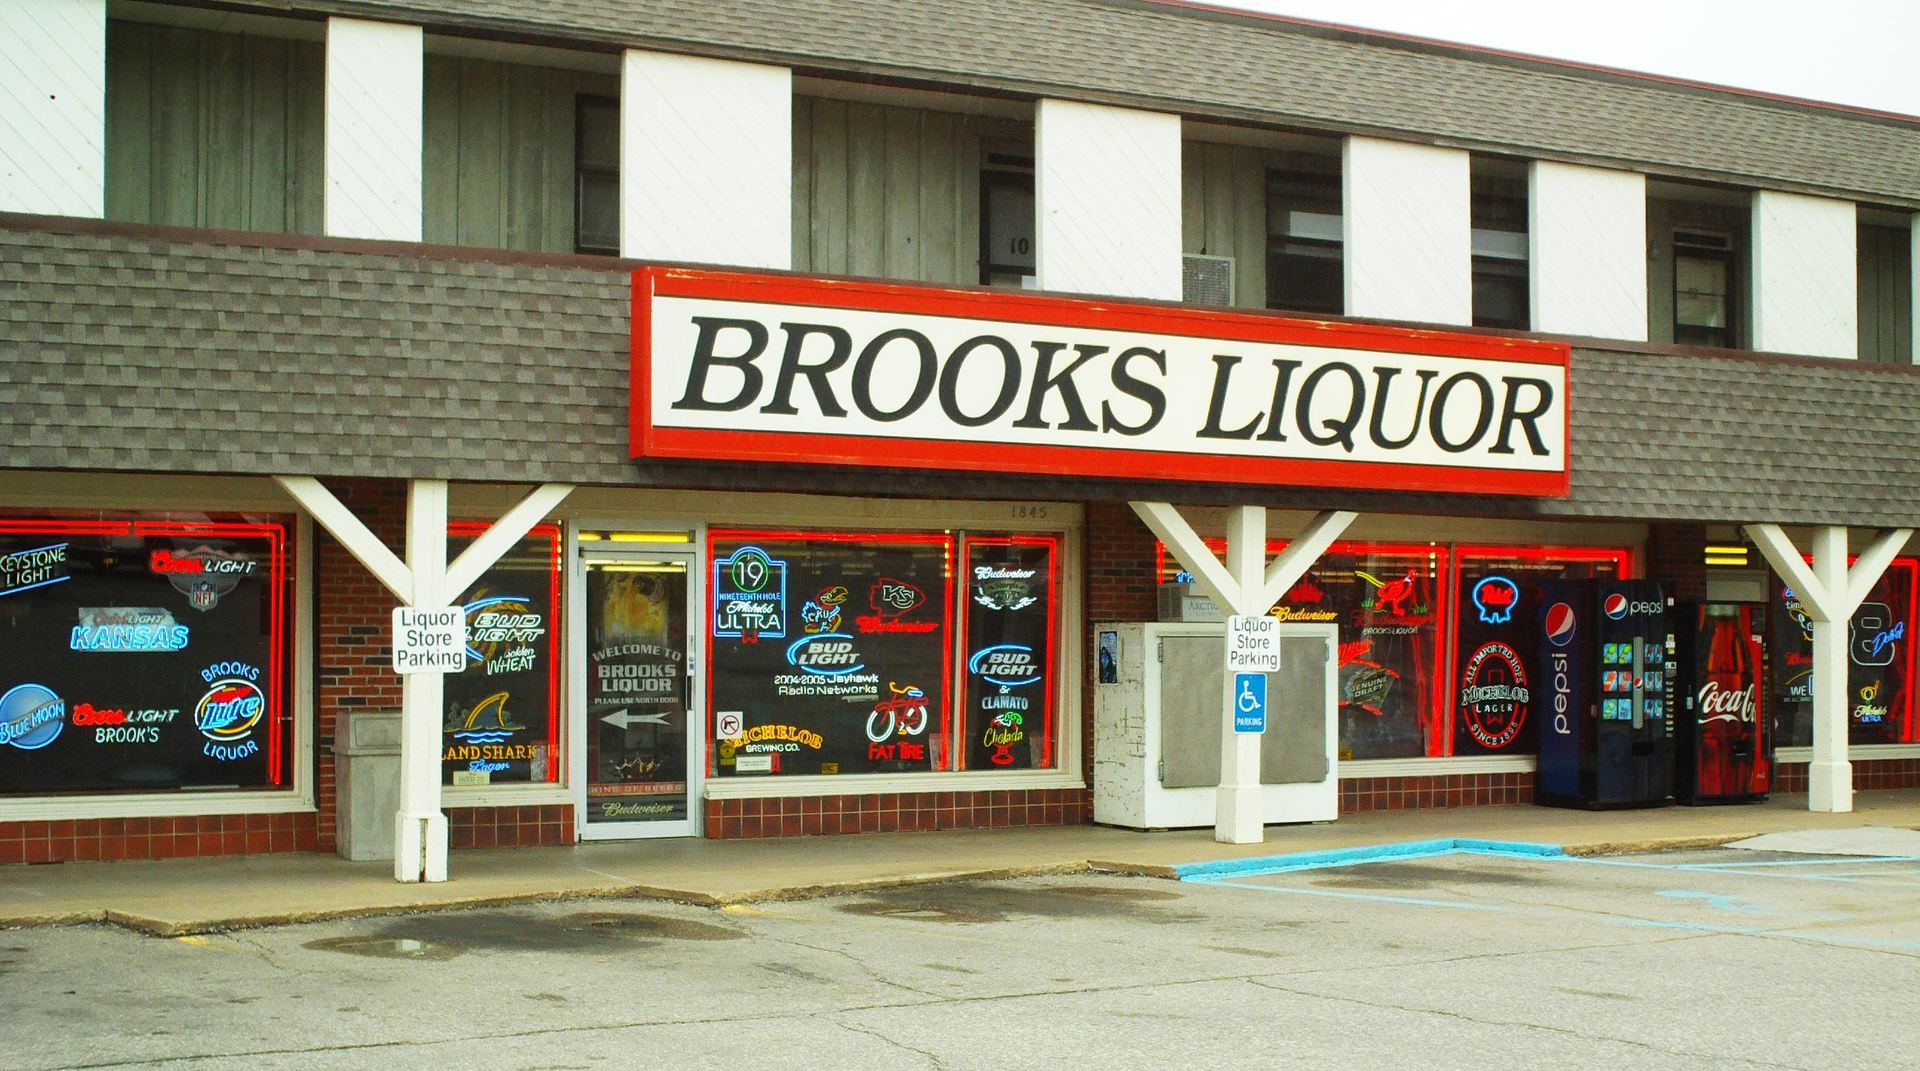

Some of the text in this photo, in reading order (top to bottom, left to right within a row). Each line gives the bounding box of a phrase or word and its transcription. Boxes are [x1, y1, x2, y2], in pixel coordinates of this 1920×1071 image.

[1009, 238, 1029, 255] 10
[671, 316, 1554, 456] BROOKS LIQUOR
[1011, 506, 1047, 518] 1845
[0, 546, 66, 572] KEYSTONE
[205, 560, 257, 573] LIGHT
[7, 566, 52, 587] LIGHT
[737, 561, 764, 587] 19
[975, 566, 1036, 580] Budweiser
[194, 591, 214, 605] NFL
[762, 592, 781, 600] HOLE
[726, 600, 774, 614] Michelob
[1270, 606, 1338, 621] Budweiser
[1630, 600, 1664, 617] pepsi
[128, 614, 164, 625] LIGHT
[401, 610, 457, 630] Liquor
[474, 613, 541, 628] BUD
[718, 613, 781, 630] ULTRA
[1234, 617, 1273, 633] Liquor
[70, 625, 189, 650] KANSAS
[407, 630, 452, 647] Store
[465, 626, 545, 642] LIGHT
[1391, 626, 1418, 635] LIQUOR
[808, 642, 852, 653] BUD
[1237, 634, 1270, 649] Store
[397, 650, 462, 669] Parking
[592, 644, 682, 661] WELCOME TO
[799, 653, 860, 665] LIGHT
[989, 653, 1031, 664] BUD
[1230, 651, 1278, 669] Parking
[201, 661, 260, 682] BROOKS
[487, 655, 536, 676] WHEAT
[598, 664, 676, 678] BROOKS
[980, 664, 1037, 675] LIGHT
[1466, 645, 1524, 684] ALL IMPORTED HOPS
[602, 678, 672, 693] LIQUOR
[774, 673, 879, 687] 2004-2005 Jayhawk
[1351, 676, 1388, 692] GENUINE
[778, 684, 878, 696] Radio Networks
[999, 685, 1010, 694] &
[1355, 684, 1384, 697] DRAFT
[1462, 685, 1529, 706] MICHELOB
[1552, 653, 1571, 734] pepsi
[1791, 685, 1807, 696] WE
[982, 697, 1028, 710] CLAMATO
[1476, 704, 1513, 713] LAGER
[72, 703, 179, 727] Coors LIGHT
[199, 697, 261, 730] Lite
[1236, 717, 1263, 726] PARKING
[0, 703, 65, 745] BLUE MOON
[95, 726, 160, 744] BROOK'S
[983, 727, 1023, 747] Chelada
[1471, 723, 1498, 746] SINCE
[203, 740, 259, 761] LIQUOR
[745, 743, 800, 753] BREWING CO.
[868, 741, 924, 760] FAT TIRE
[601, 803, 674, 817] Budweiser
